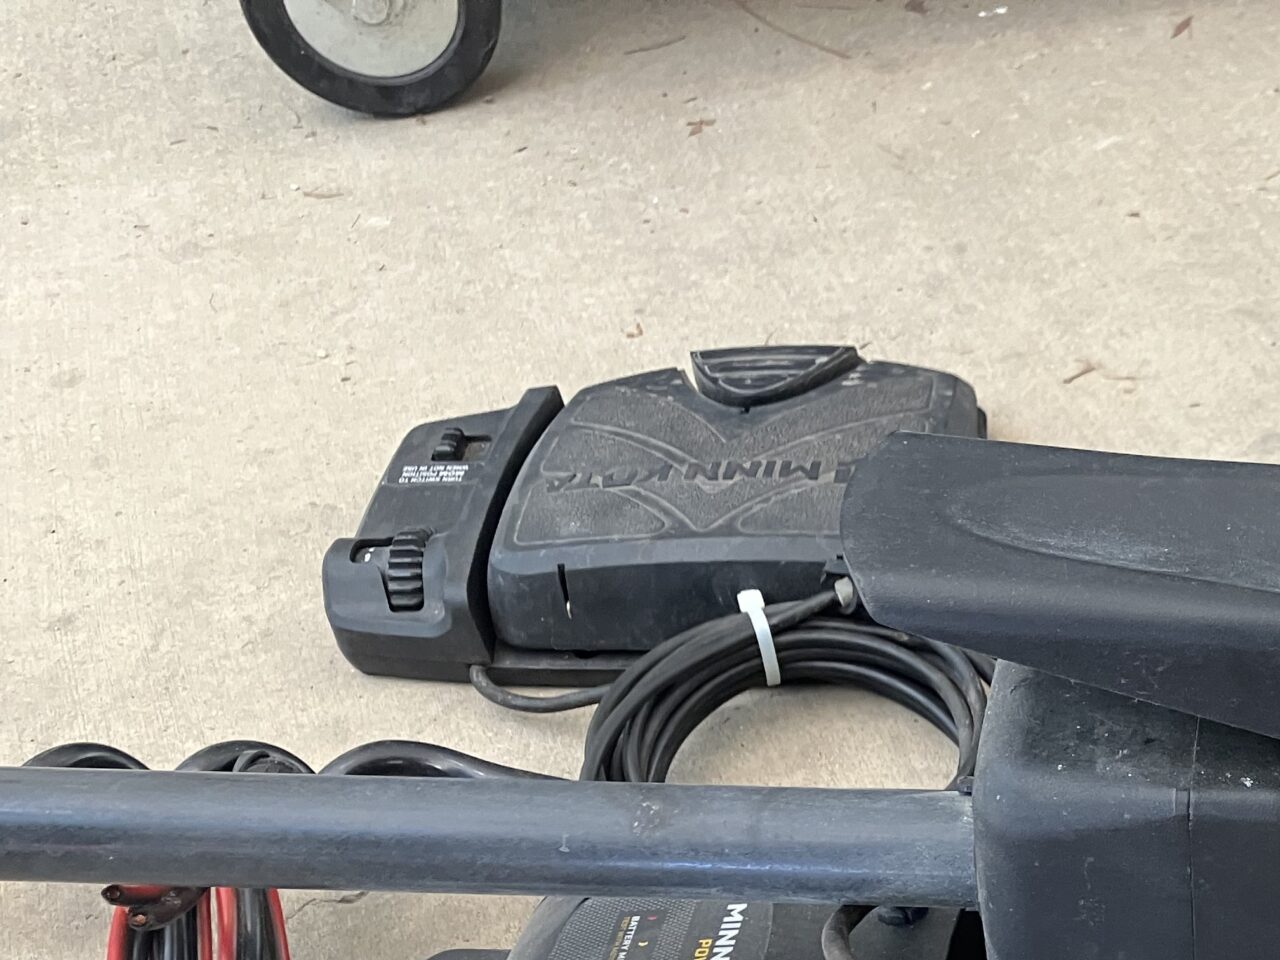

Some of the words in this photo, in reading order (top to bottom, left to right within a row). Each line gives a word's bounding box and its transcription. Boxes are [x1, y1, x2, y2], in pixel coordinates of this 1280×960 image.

[546, 461, 673, 493] KOTA
[684, 460, 822, 481] MINN
[620, 915, 641, 950] BATTERY
